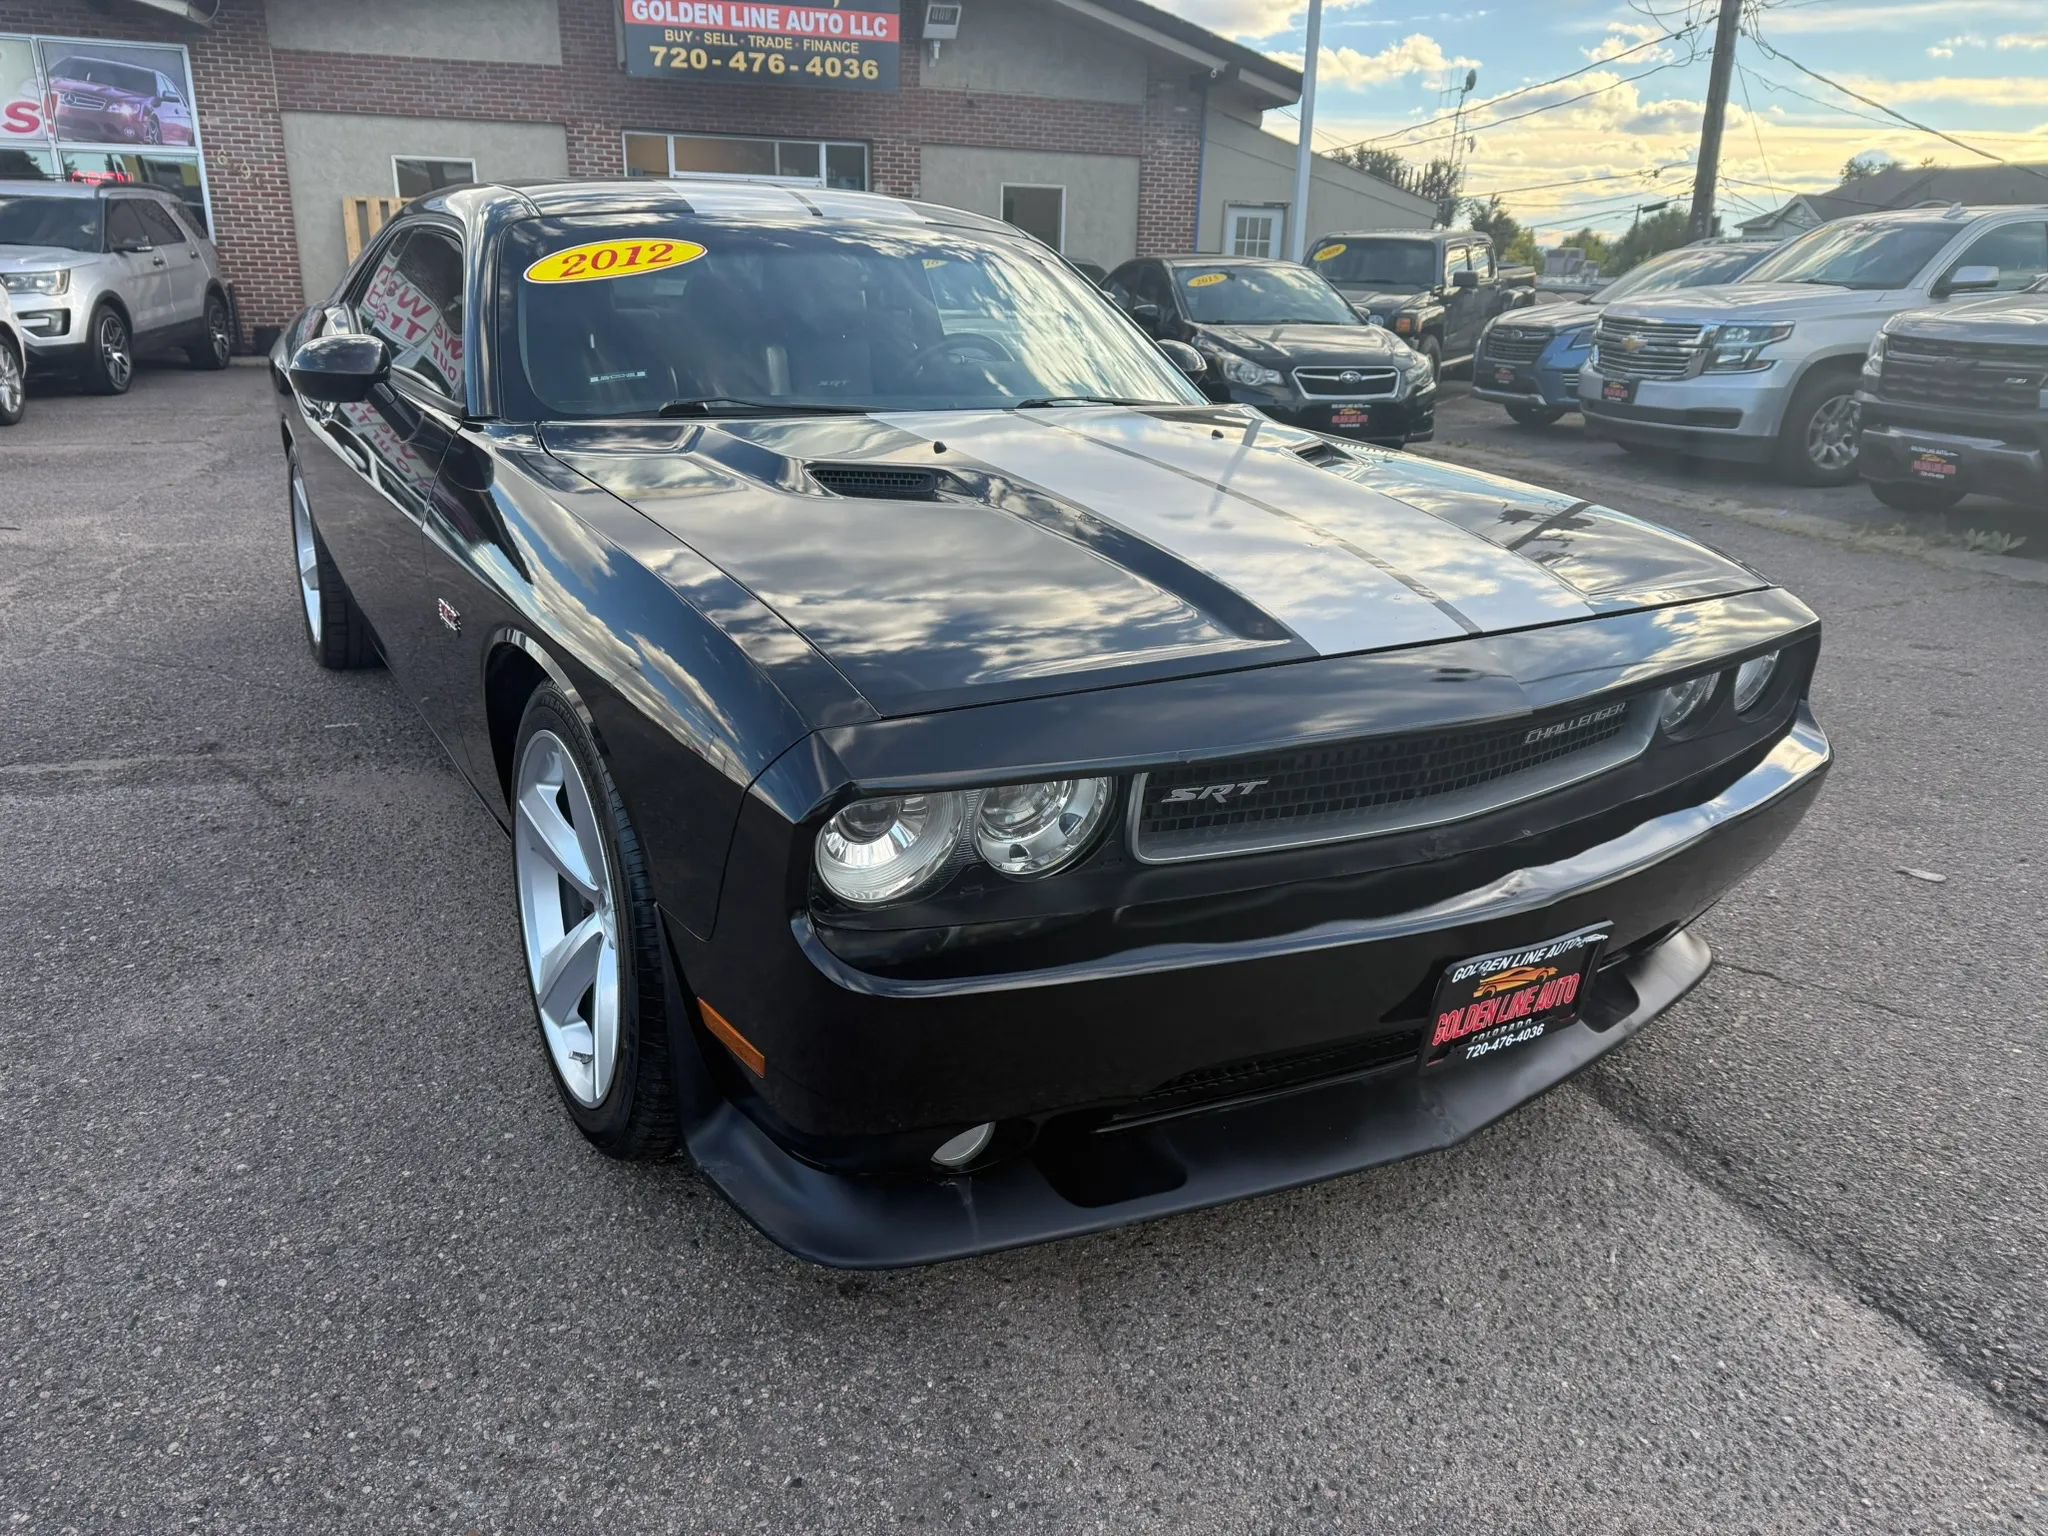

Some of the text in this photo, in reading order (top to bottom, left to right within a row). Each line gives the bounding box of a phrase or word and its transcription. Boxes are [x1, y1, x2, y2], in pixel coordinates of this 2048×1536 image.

[631, 0, 888, 38] GOLDEN LINE AUTO LLC
[664, 29, 859, 54] BUY SELL TRADE FINANCE
[649, 45, 879, 80] 720-476-4036
[560, 243, 674, 278] 2012
[1524, 702, 1627, 746] CHALLENGER
[1161, 779, 1271, 804] SRT
[1451, 936, 1582, 984] GOLDEN LINE AUTO
[1431, 972, 1580, 1047] GOLDEN LINE AUTO
[1465, 1022, 1546, 1060] 720-476-4036
